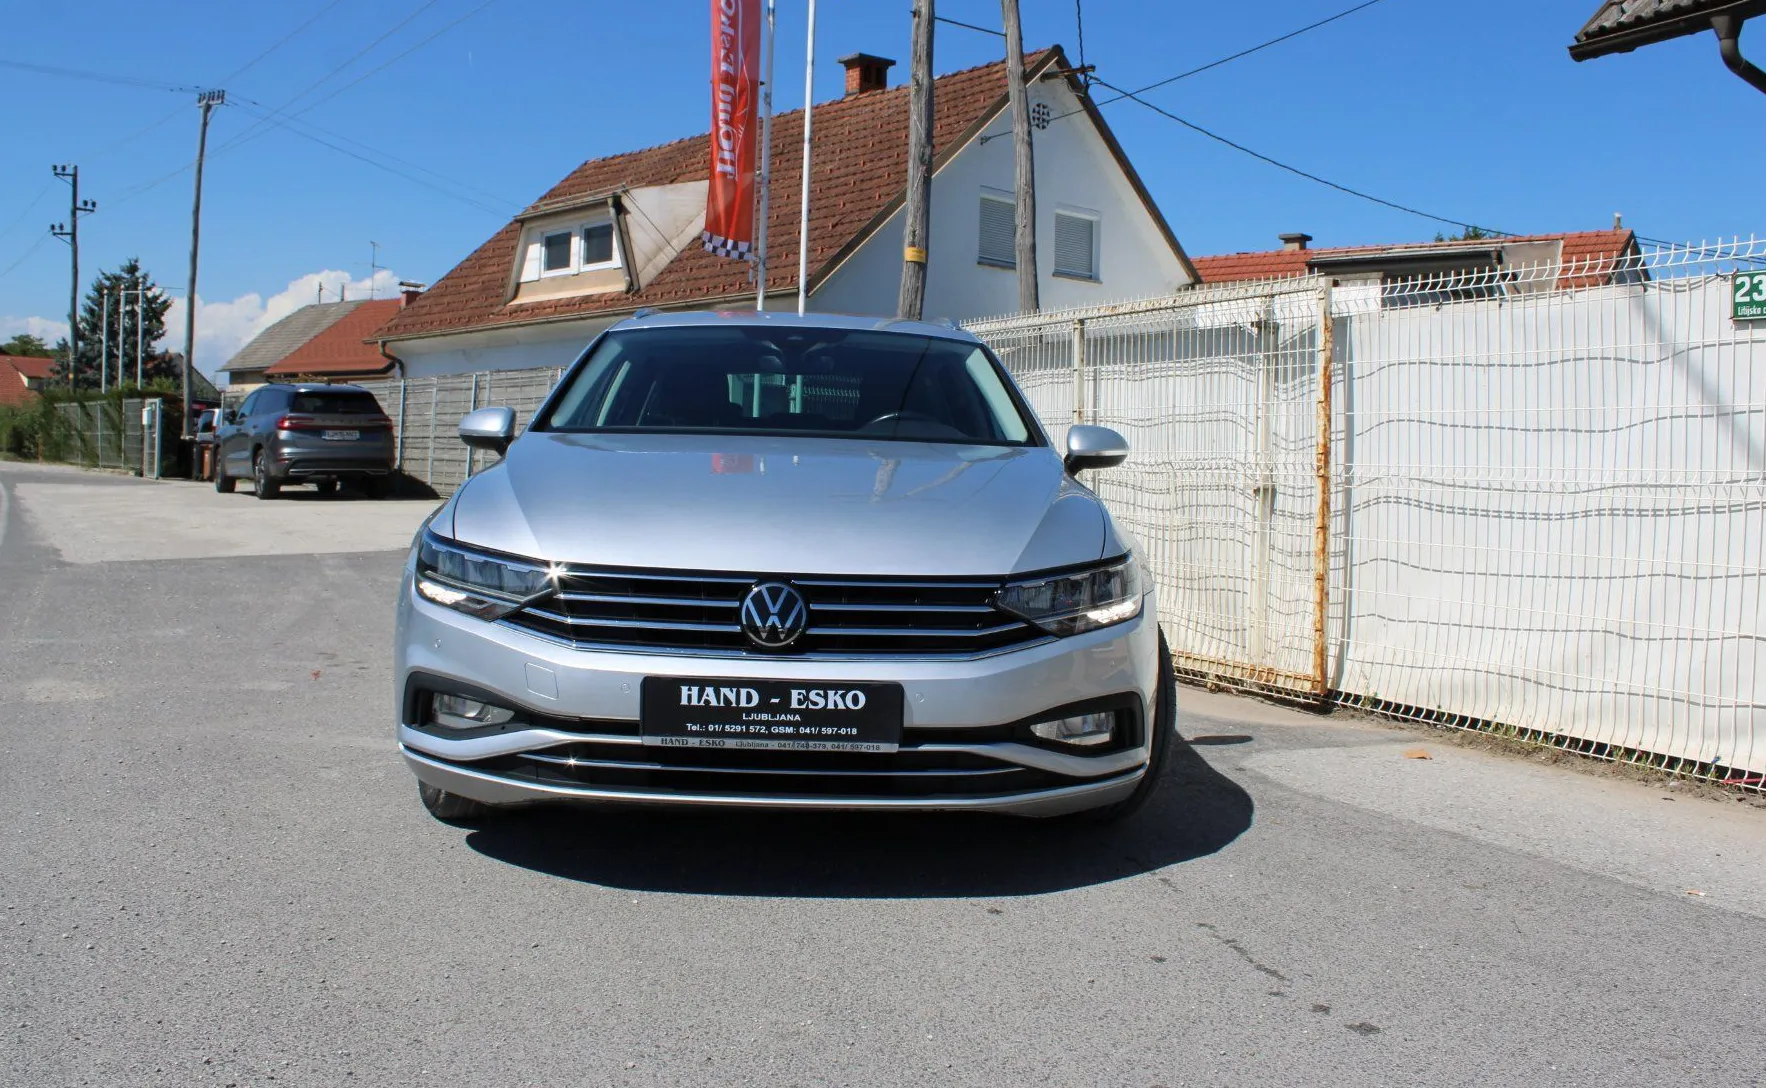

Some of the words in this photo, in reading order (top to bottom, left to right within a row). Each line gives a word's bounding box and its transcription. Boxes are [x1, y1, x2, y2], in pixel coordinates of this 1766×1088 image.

[745, 584, 803, 640] VW
[679, 685, 760, 708] HAND
[790, 689, 867, 710] ESKO
[742, 712, 801, 721] LJUBLJANA
[686, 723, 706, 731] Tel.:
[708, 724, 722, 732] 01/
[724, 724, 746, 733] 5291
[749, 725, 768, 734] 572,
[771, 726, 797, 734] GSM:
[799, 726, 819, 734] 041/
[821, 727, 858, 735] 597-018
[661, 737, 689, 746] HAND
[699, 739, 726, 748] ESKO
[735, 740, 769, 749] Ljubljana
